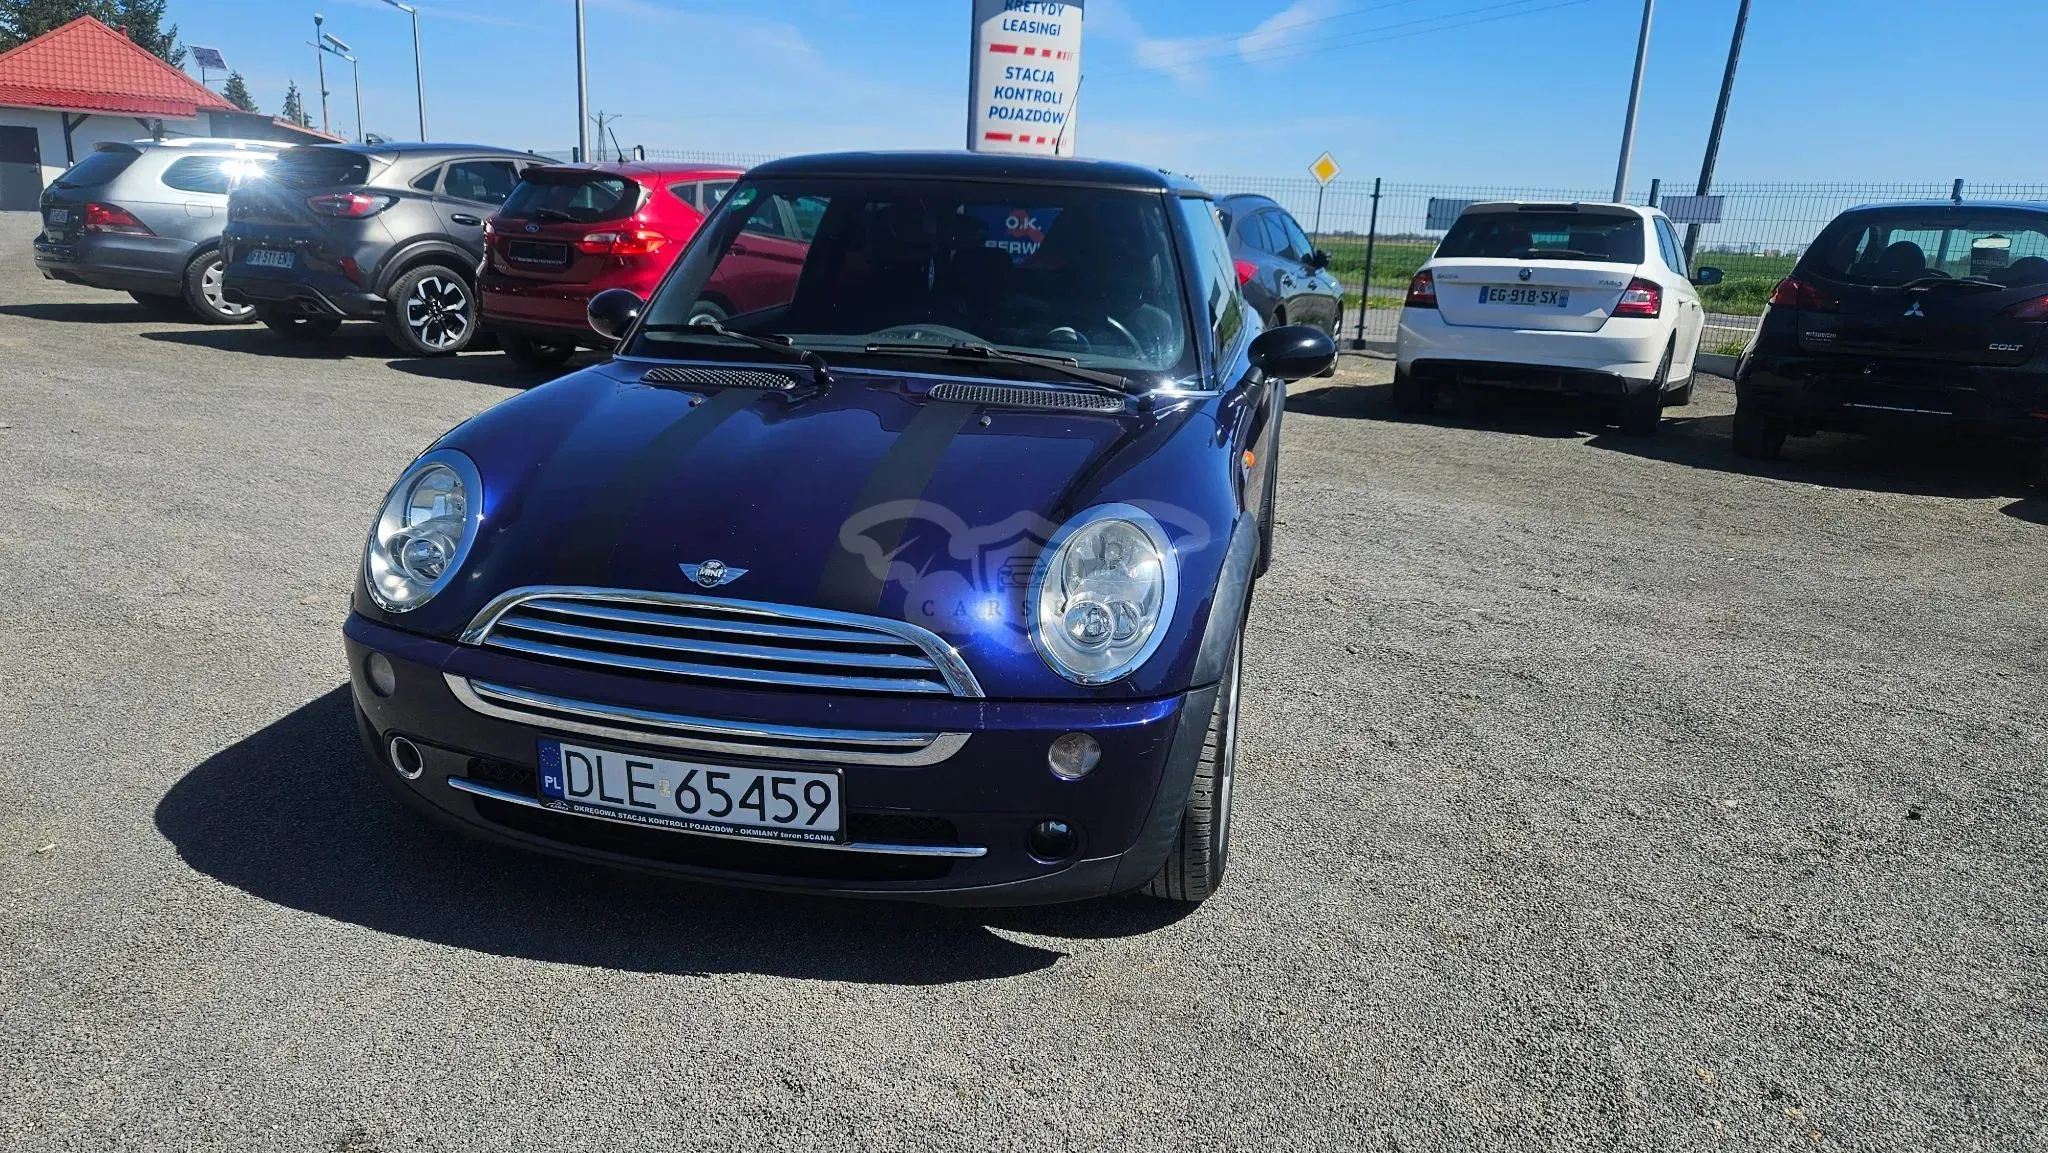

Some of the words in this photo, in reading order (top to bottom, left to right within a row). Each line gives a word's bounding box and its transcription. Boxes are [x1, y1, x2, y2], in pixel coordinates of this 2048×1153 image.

[1004, 0, 1065, 16] KRETYDY
[1003, 18, 1061, 36] LEASINGI
[1005, 66, 1055, 84] STACJA
[994, 86, 1063, 105] KONTROLI
[988, 105, 1065, 124] POJAZDÓW
[1989, 343, 2024, 351] COLT
[544, 775, 562, 790] PL
[564, 749, 657, 810] DLE
[674, 769, 832, 826] 65459
[573, 804, 617, 819] OKRĘGOWA
[617, 813, 647, 823] STACJA
[648, 817, 688, 829] KONTROLI
[689, 822, 734, 834] POJAZDÓW
[740, 828, 779, 838] OKMIANY
[780, 831, 802, 839] teren
[803, 833, 836, 842] SCANIA
